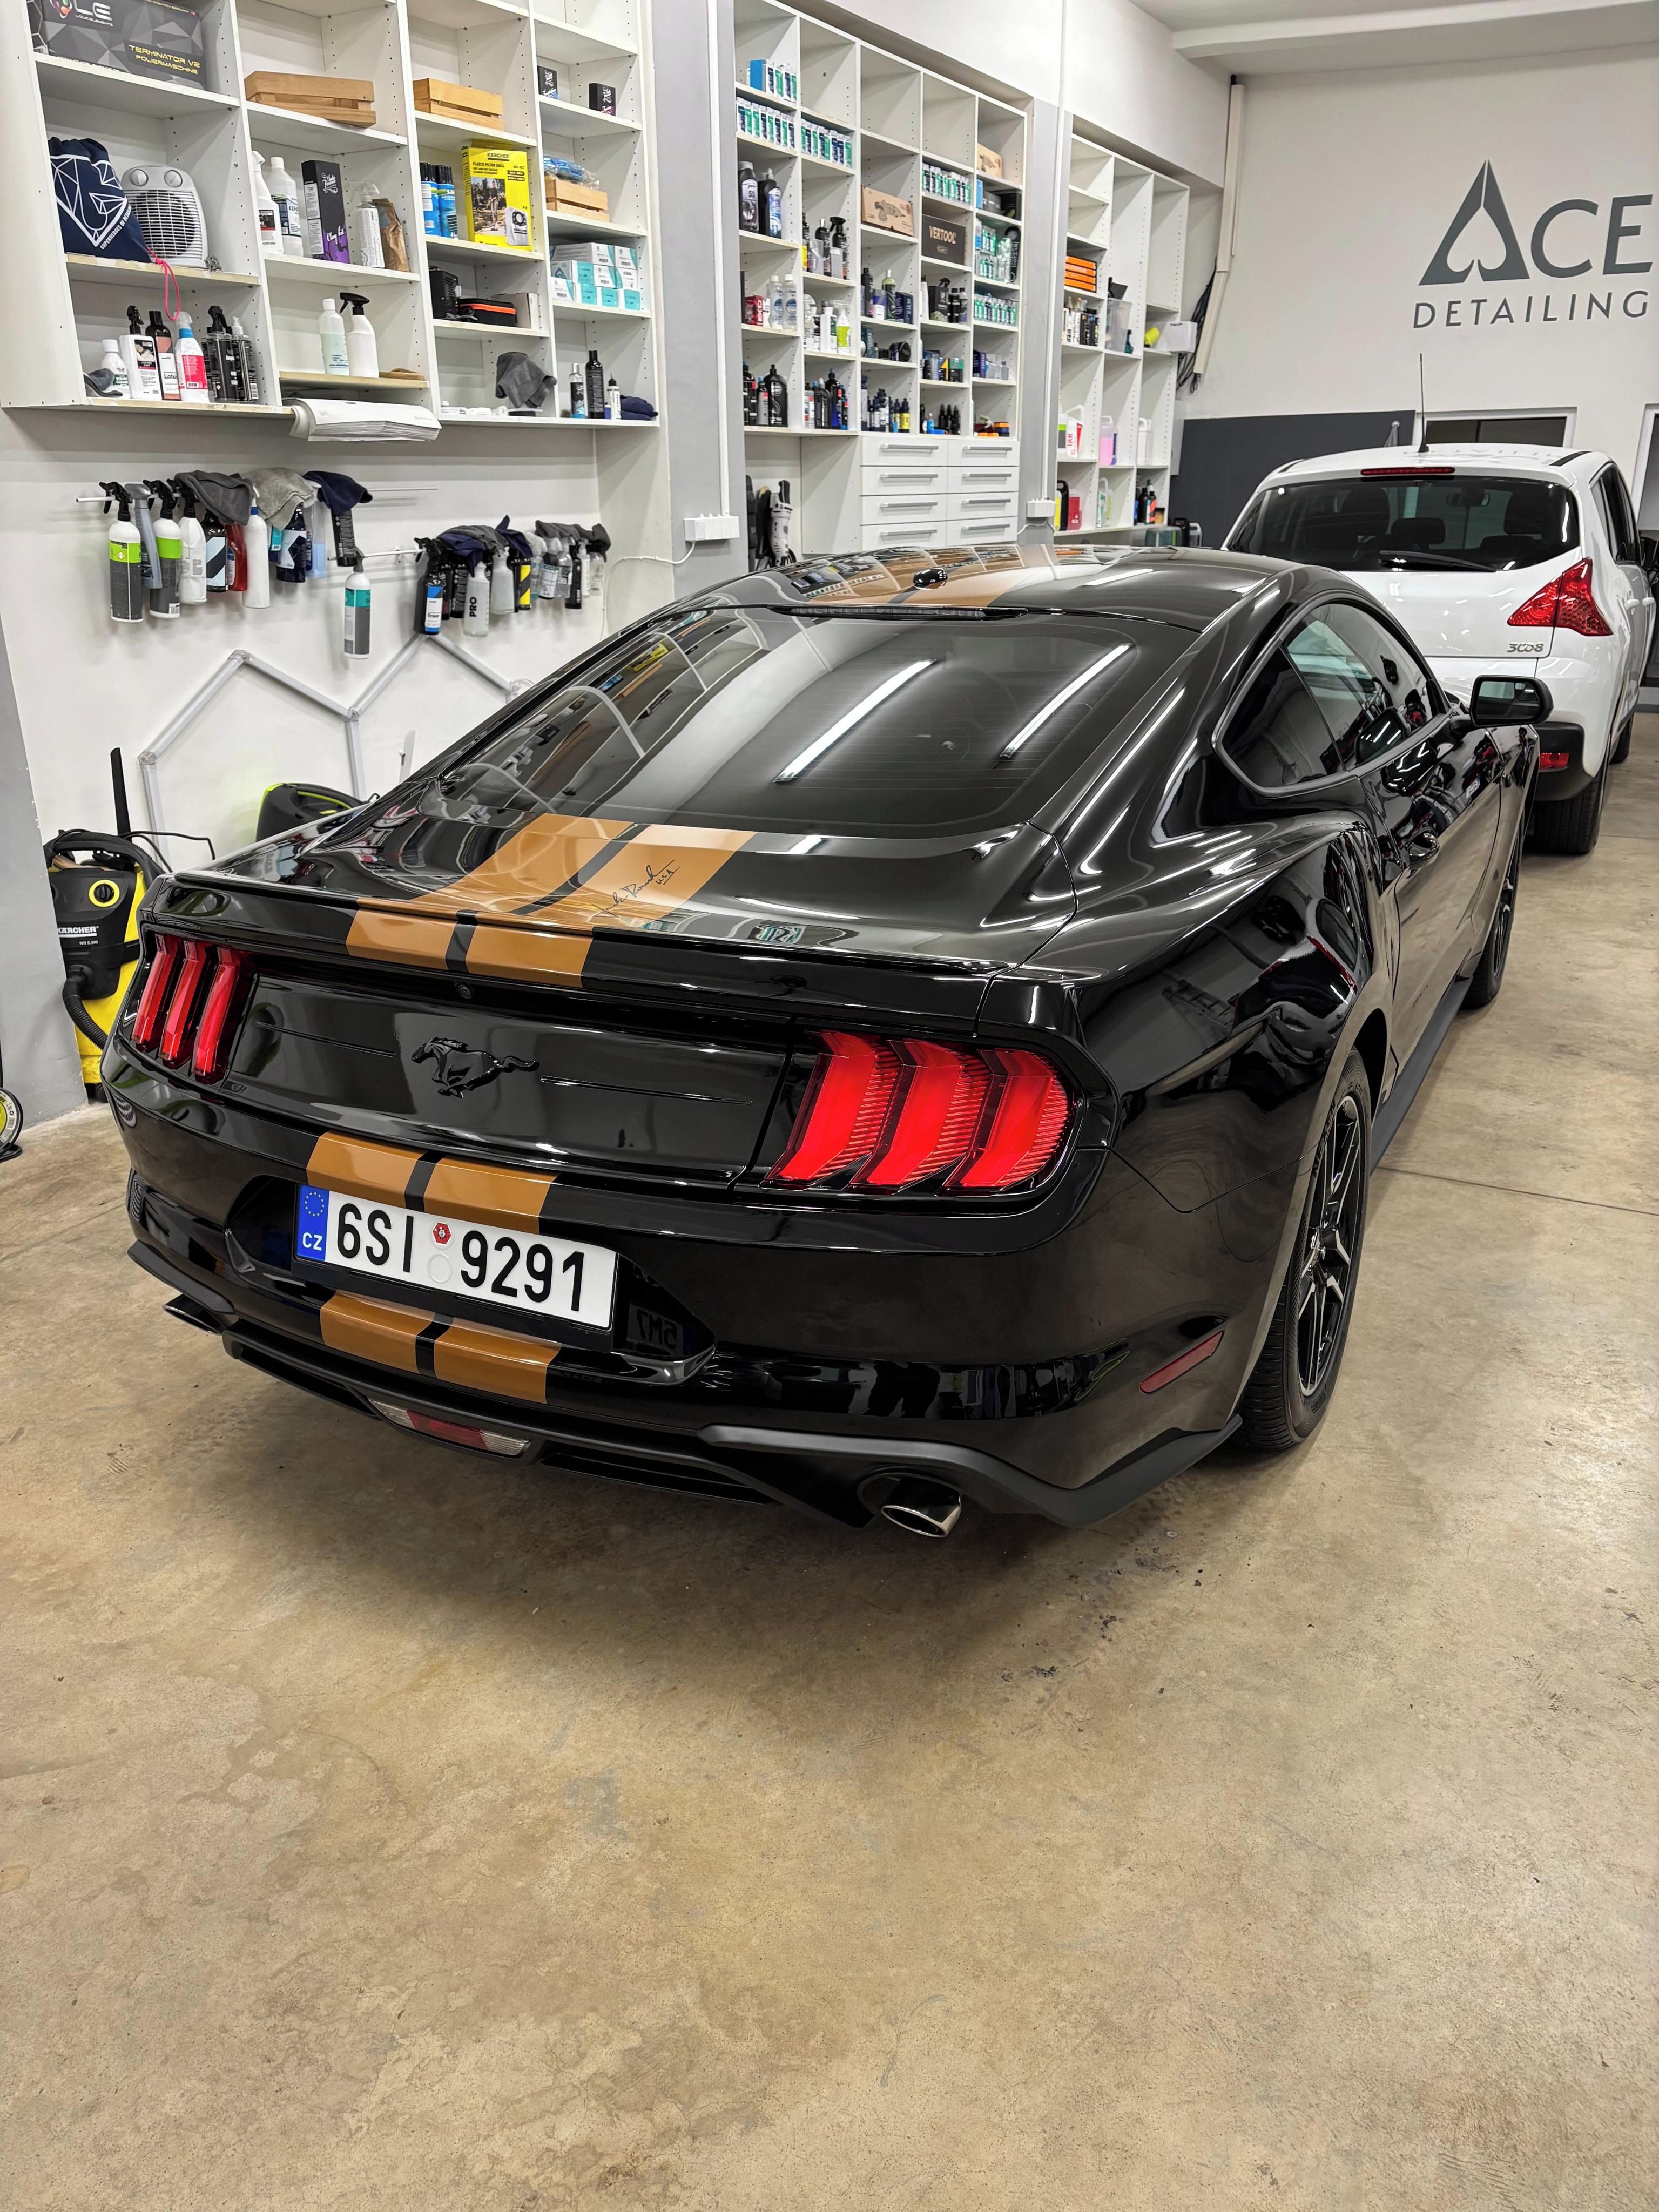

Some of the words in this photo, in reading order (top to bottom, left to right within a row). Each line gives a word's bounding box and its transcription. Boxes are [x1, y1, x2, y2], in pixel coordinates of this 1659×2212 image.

[129, 44, 186, 64] TERMINATOR
[187, 59, 200, 68] V2
[135, 55, 199, 75] POLIERMASCHINE
[929, 225, 956, 244] VERTOOL
[1418, 159, 1654, 286] ACE
[100, 225, 122, 250] SUPERHEROES
[1413, 289, 1649, 328] DETAILING
[469, 596, 477, 618] PRO
[1506, 643, 1544, 653] 3008
[302, 1233, 322, 1252] CZ
[460, 1230, 585, 1312] 9291
